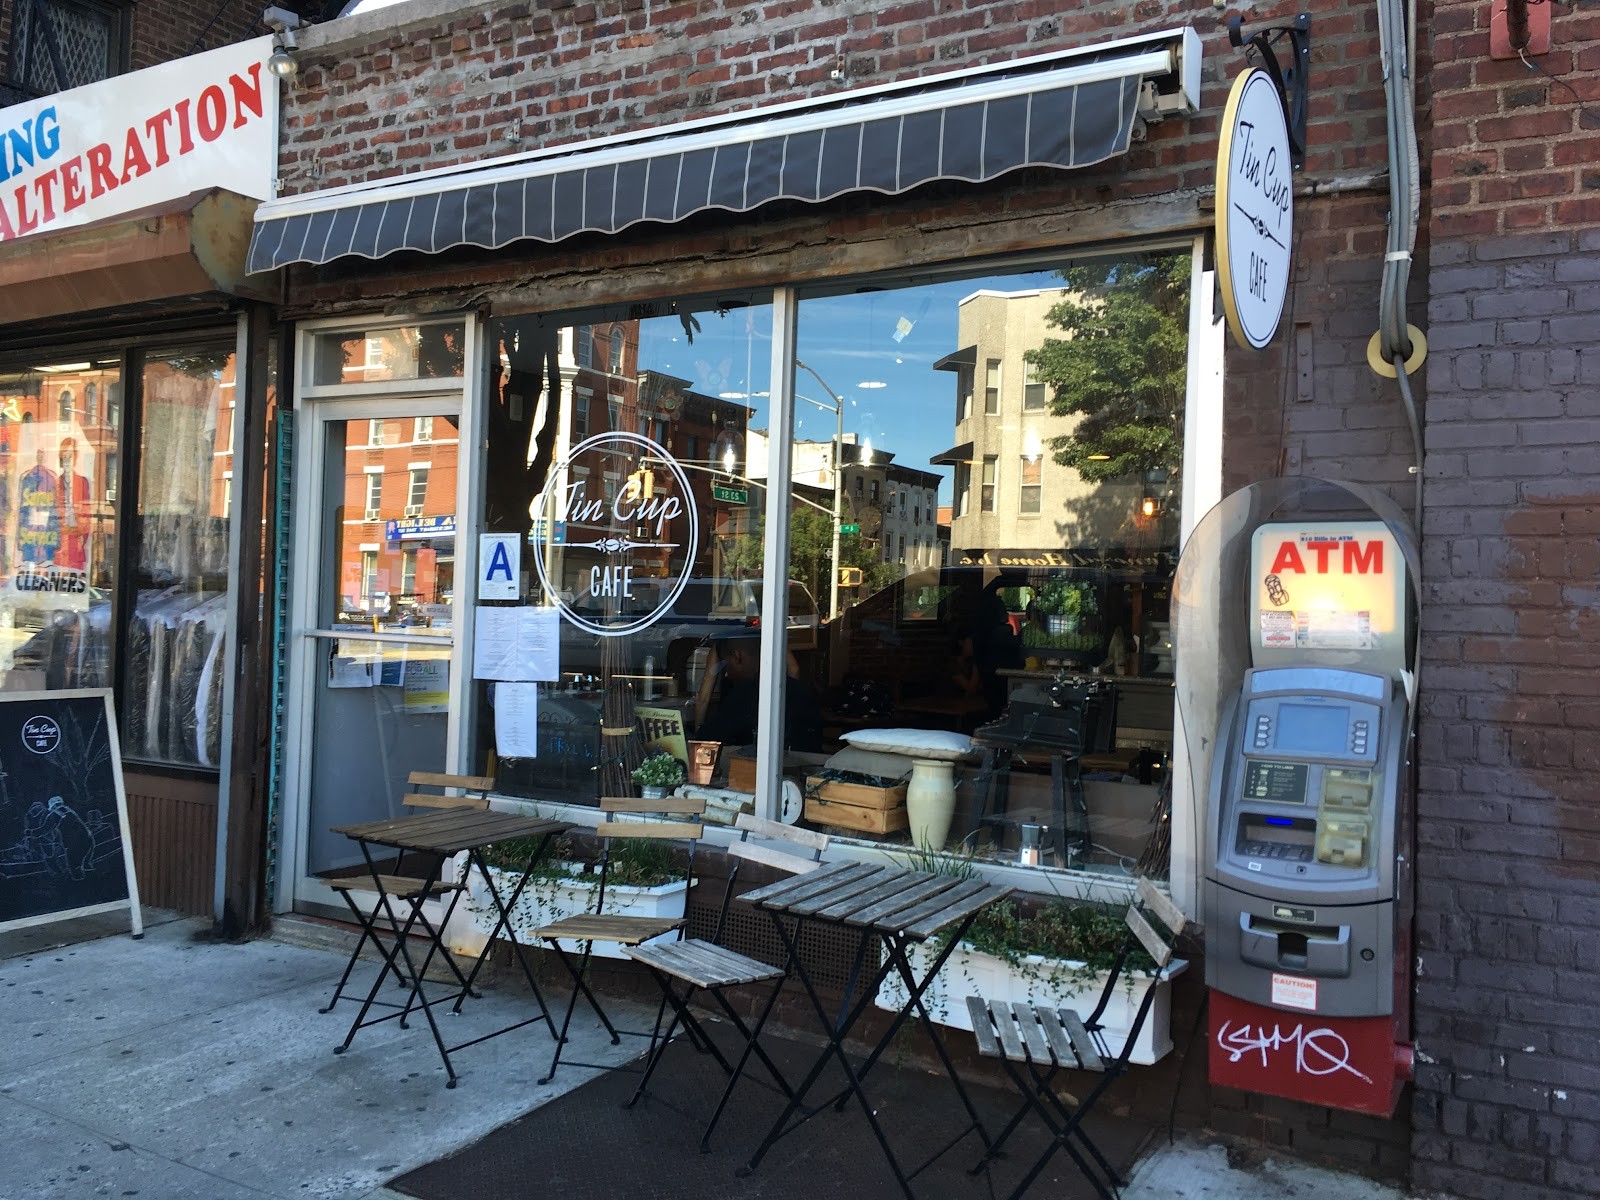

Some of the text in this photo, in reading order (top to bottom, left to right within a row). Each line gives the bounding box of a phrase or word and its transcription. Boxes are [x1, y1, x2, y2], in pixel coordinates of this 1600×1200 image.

[1240, 121, 1289, 229] Tin Cup
[1250, 251, 1268, 302] CAFE
[556, 480, 603, 523] Tin
[614, 479, 682, 536] Cup
[486, 542, 513, 581] A
[1270, 540, 1384, 574] ATM
[16, 570, 87, 593] CLEANERS
[590, 565, 633, 598] CAFE
[40, 723, 57, 735] Cup
[1273, 978, 1315, 990] CAUTION!
